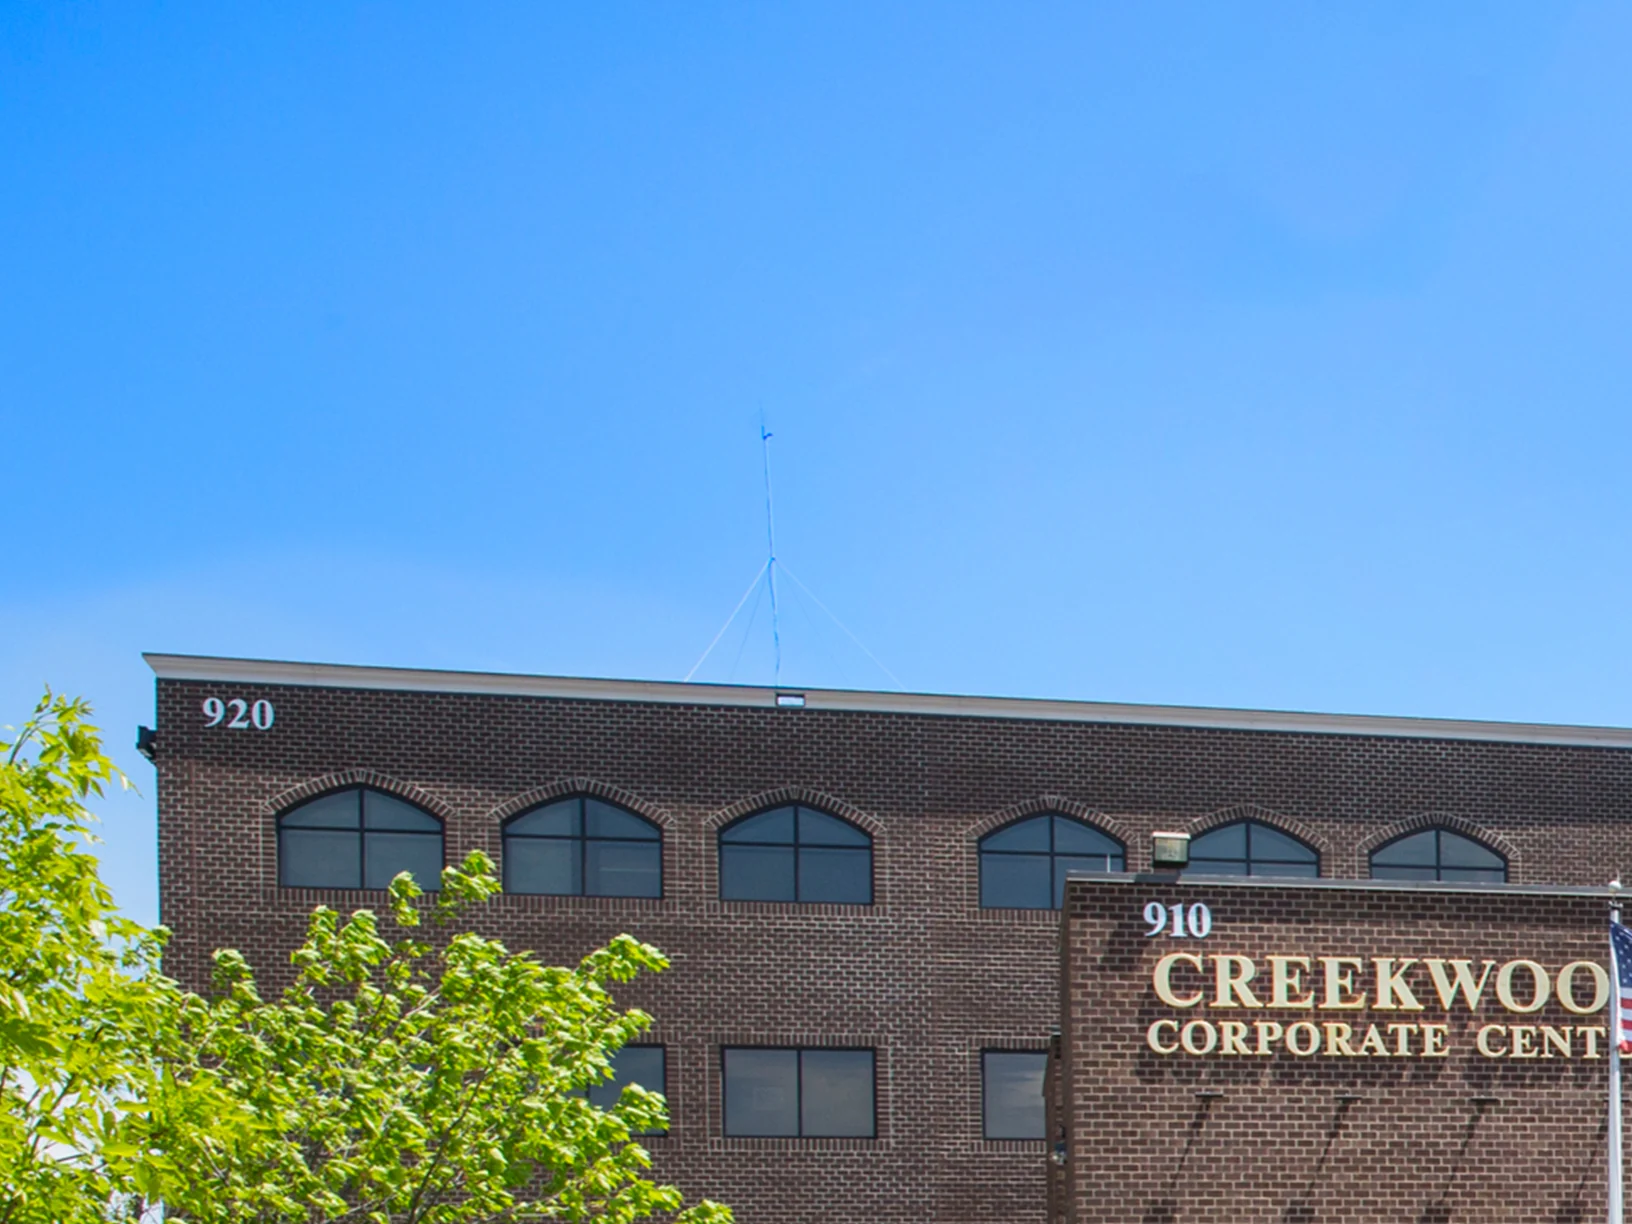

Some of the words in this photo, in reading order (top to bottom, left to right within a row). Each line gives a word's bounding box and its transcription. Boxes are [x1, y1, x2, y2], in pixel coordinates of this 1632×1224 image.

[202, 697, 275, 730] 920
[1143, 902, 1212, 938] 910
[1153, 952, 1611, 1014] CREEKWOO
[1147, 1019, 1450, 1058] CORPORATE
